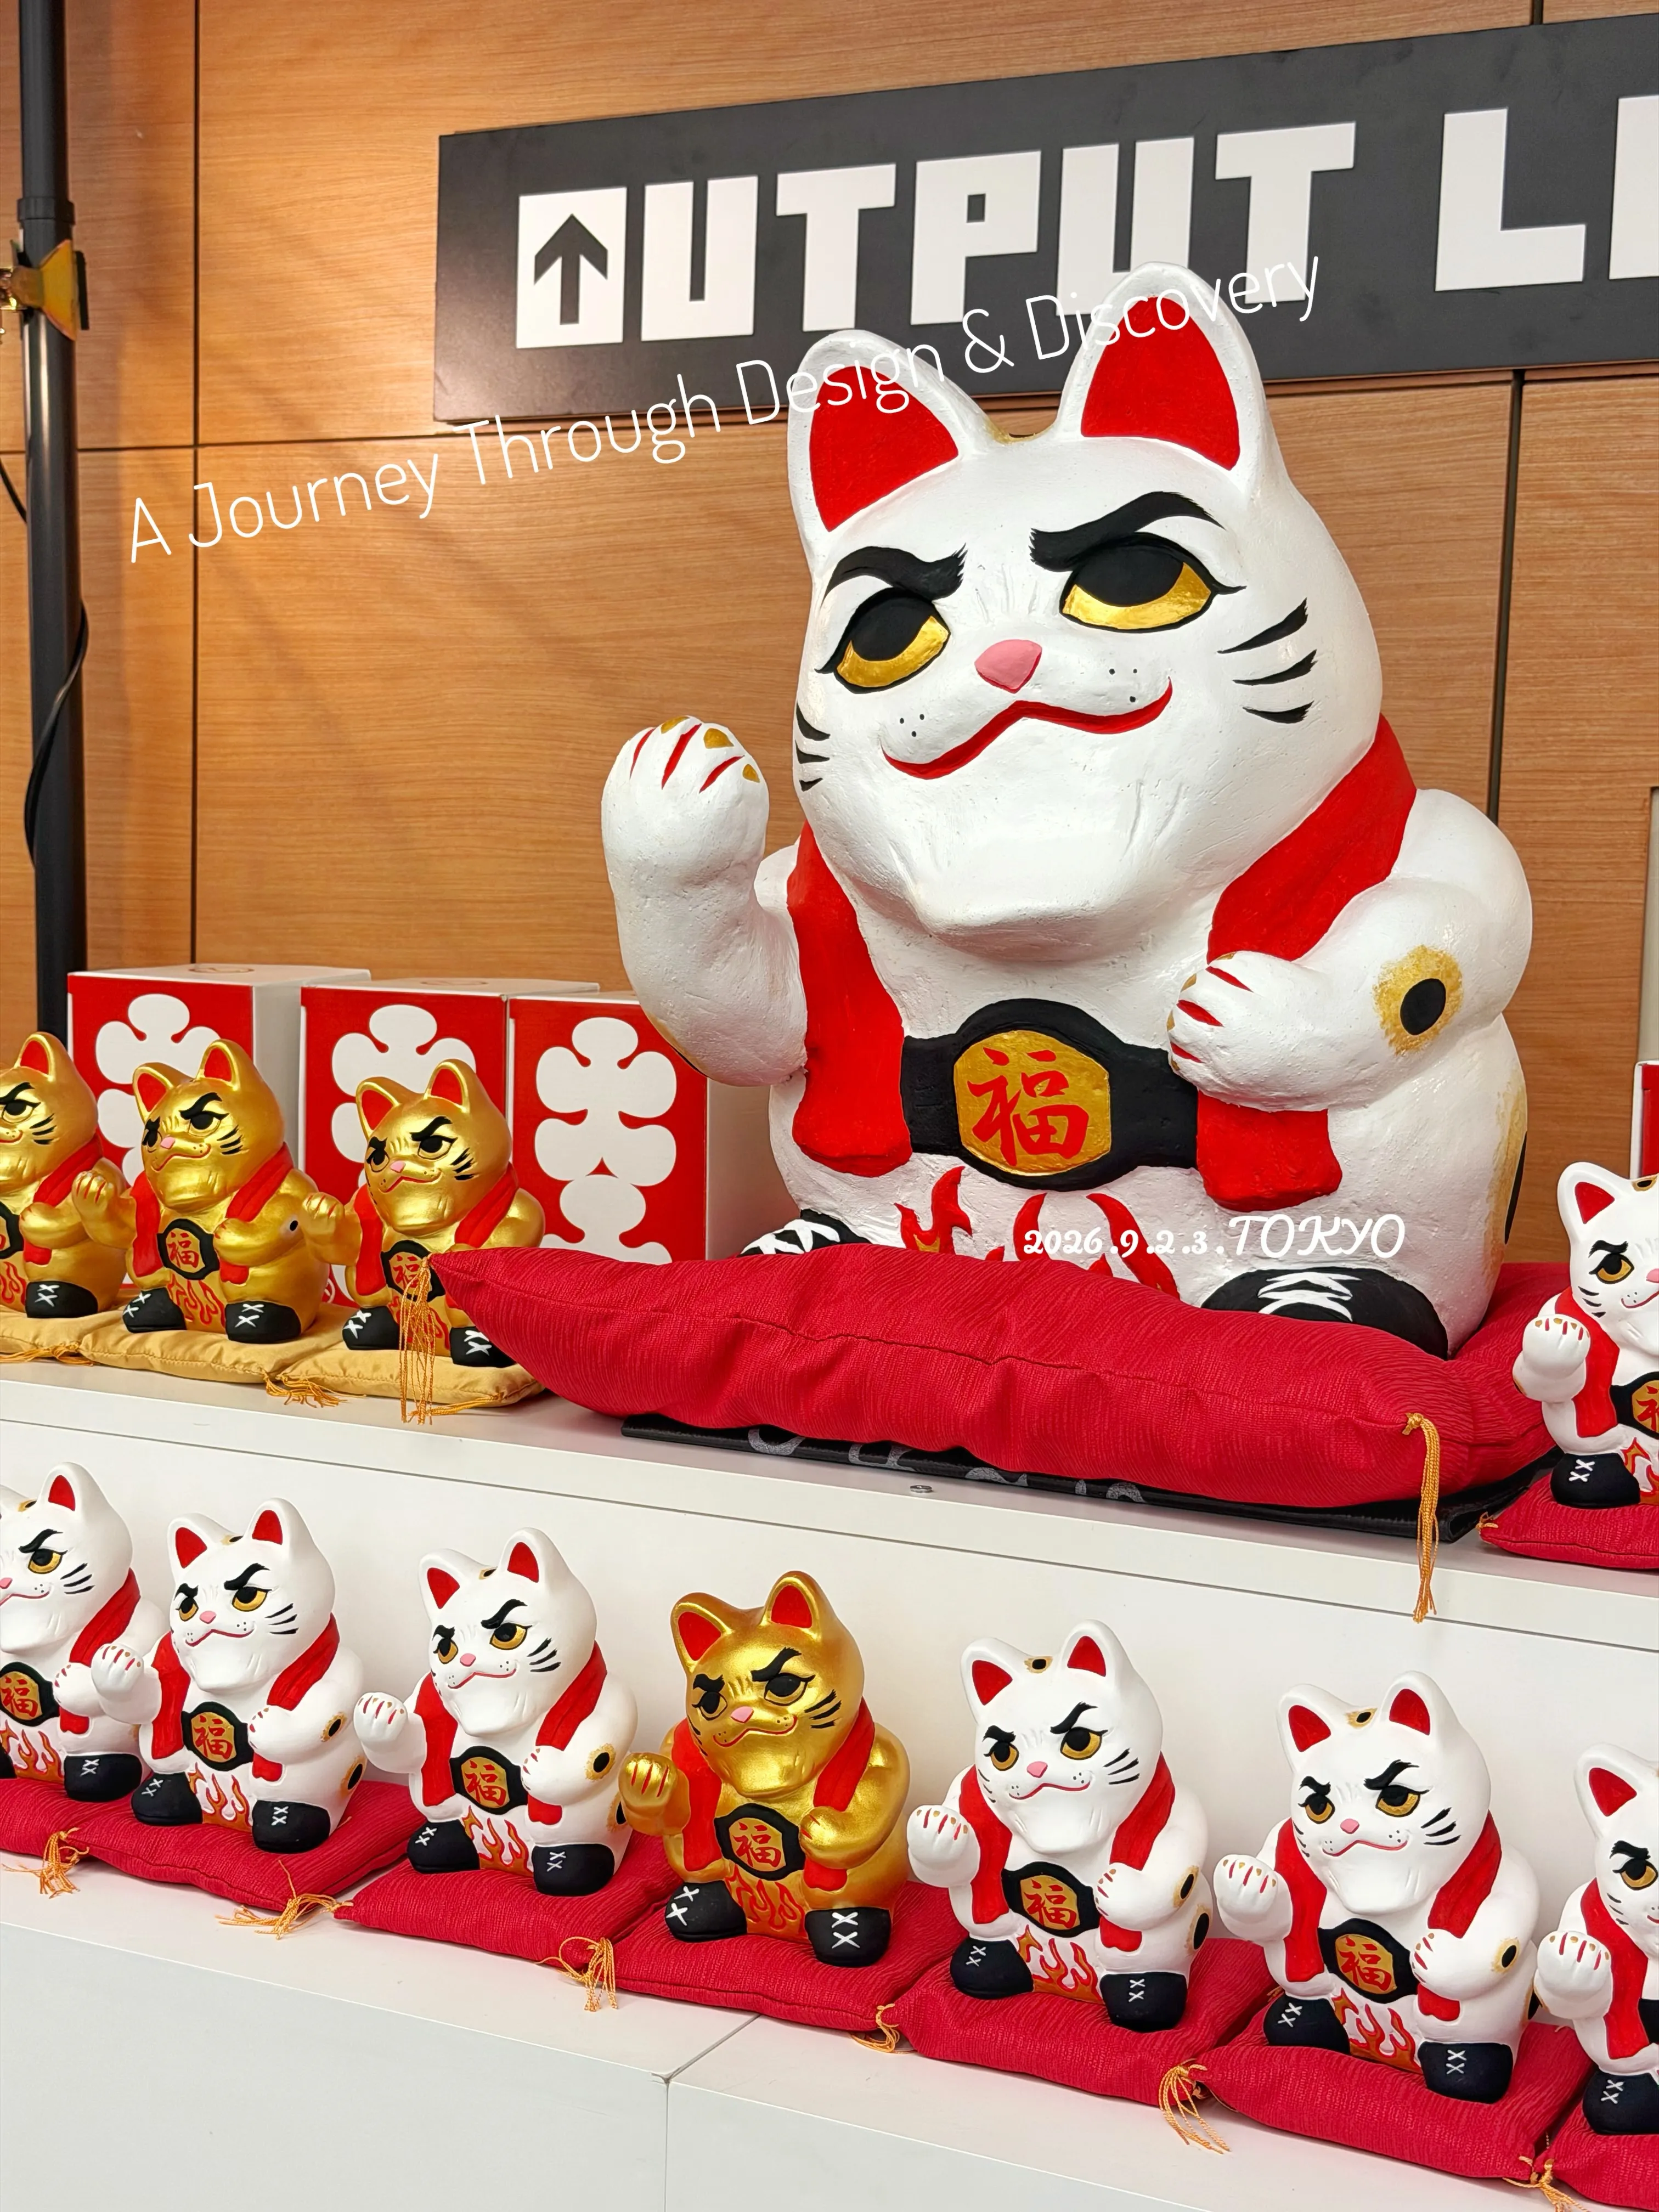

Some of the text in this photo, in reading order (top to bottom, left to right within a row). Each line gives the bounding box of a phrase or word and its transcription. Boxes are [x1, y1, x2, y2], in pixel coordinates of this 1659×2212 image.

[967, 1047, 1089, 1167] 福
[167, 1232, 199, 1268] 福
[0, 1677, 37, 1718] 福
[194, 1715, 233, 1760] 福
[465, 1760, 506, 1807] 福
[733, 1822, 782, 1868] 福
[1025, 1880, 1077, 1929] 福
[1338, 1937, 1391, 1992] 福
